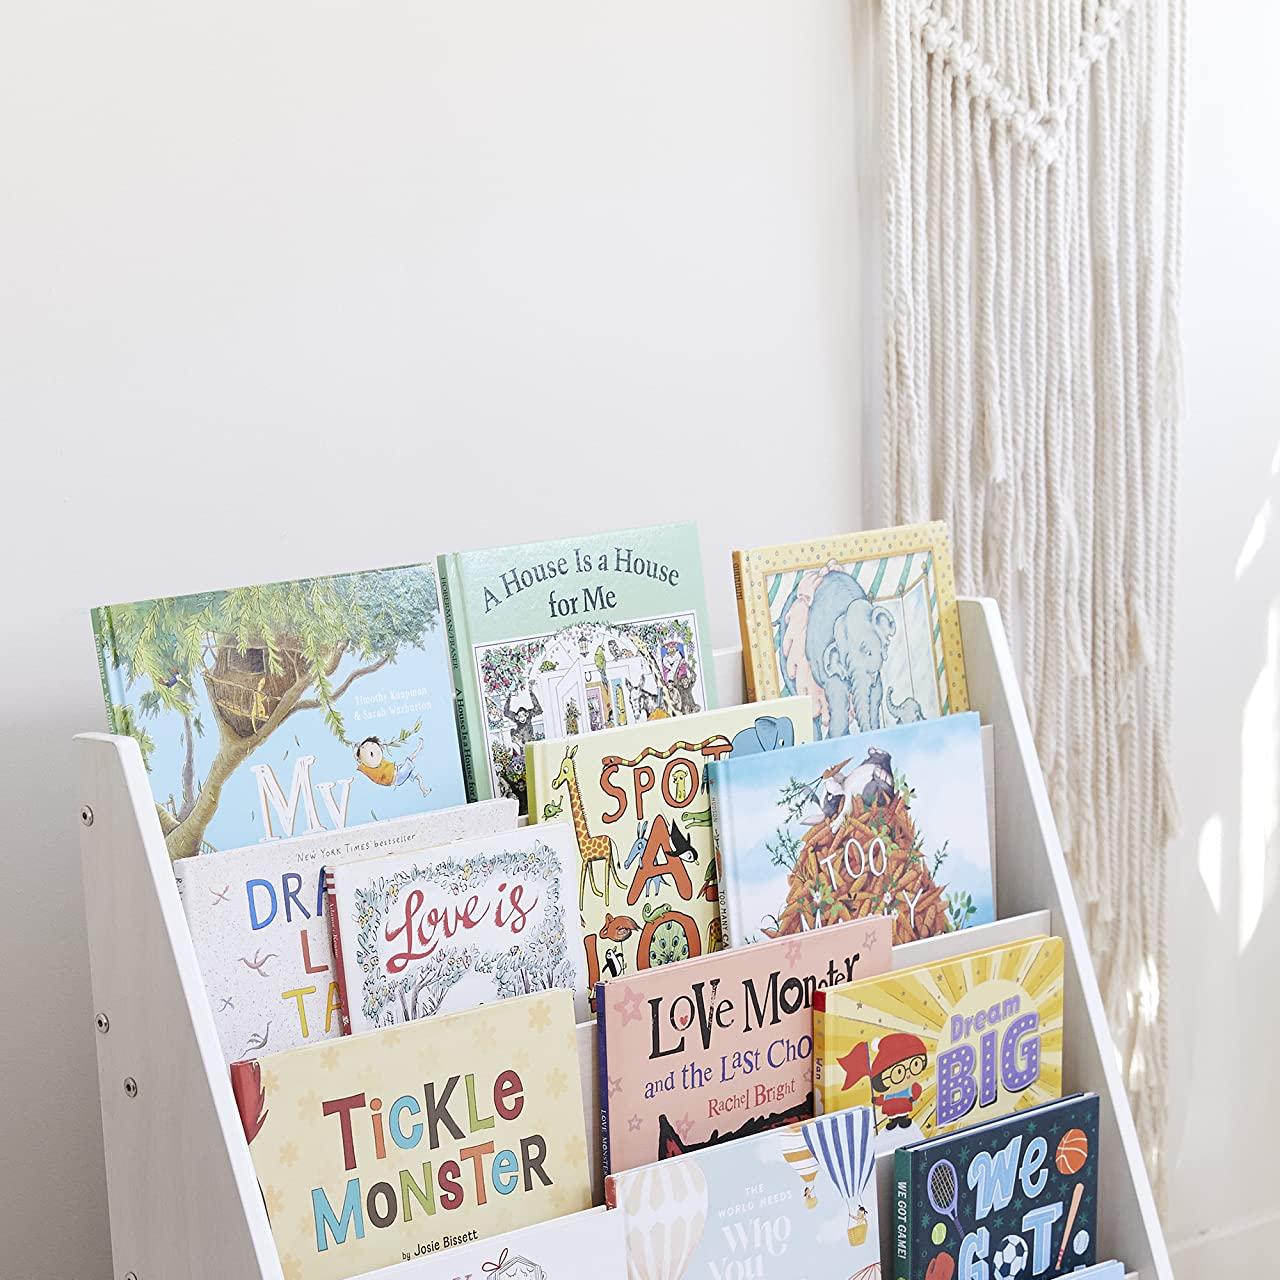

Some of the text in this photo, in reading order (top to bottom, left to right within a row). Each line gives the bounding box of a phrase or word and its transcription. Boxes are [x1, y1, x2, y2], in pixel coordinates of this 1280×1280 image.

[481, 548, 680, 613] A House Is a House
[548, 585, 617, 618] for Me
[456, 699, 467, 730] House
[464, 749, 474, 780] House
[374, 834, 416, 848] bestseller
[626, 814, 693, 905] A
[820, 837, 888, 891] TOO
[385, 883, 538, 974] Love is
[950, 994, 1021, 1044] Dream
[644, 1072, 675, 1099] and
[682, 1061, 713, 1090] the
[720, 1048, 761, 1084] Last
[936, 1011, 1041, 1128] BIG
[707, 1078, 796, 1118] Rachel Bright
[744, 1183, 765, 1196] THE
[967, 1135, 1048, 1221] We
[719, 1190, 793, 1218] WORLD NEEDS
[897, 1181, 907, 1260] WE GOT GAME!
[402, 1229, 479, 1261] by Josie Bissett
[721, 1216, 792, 1256] Who
